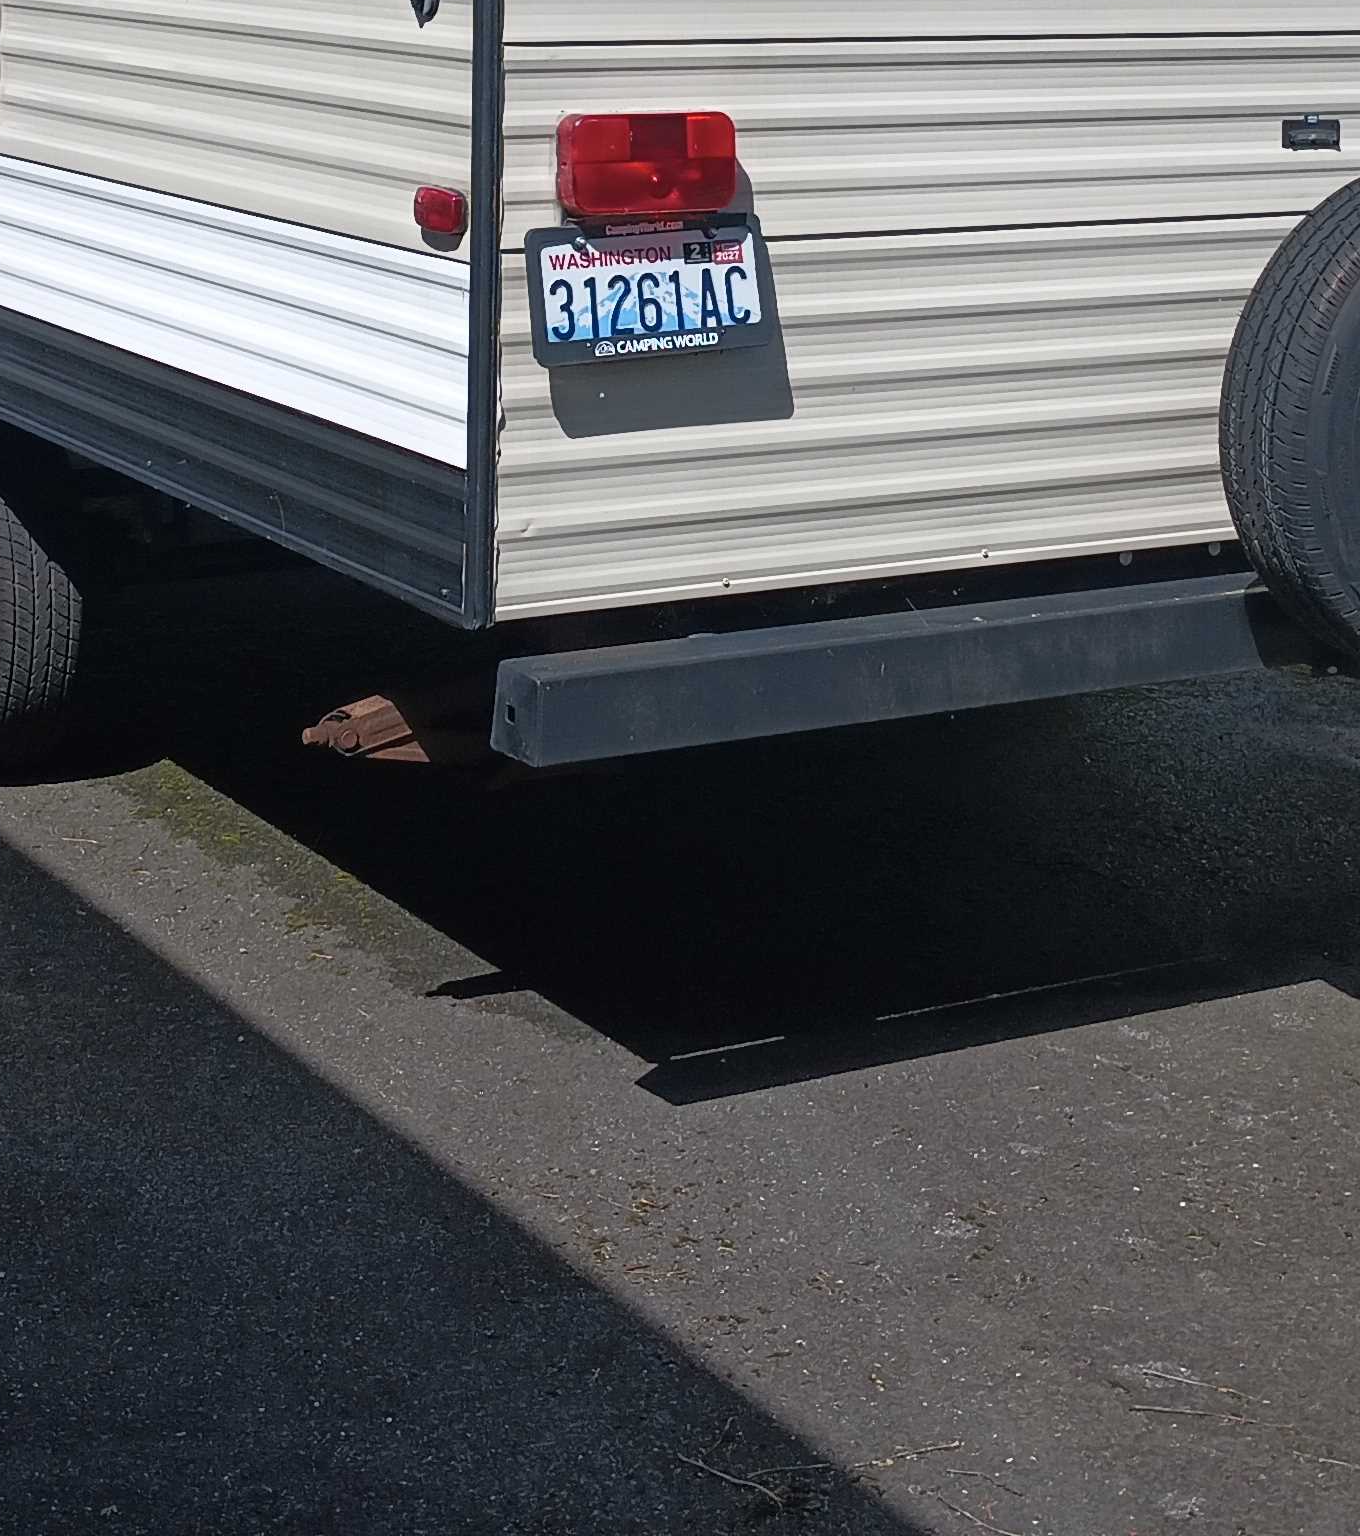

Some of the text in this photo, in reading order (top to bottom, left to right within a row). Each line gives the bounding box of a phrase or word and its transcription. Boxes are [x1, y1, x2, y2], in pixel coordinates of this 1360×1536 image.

[549, 246, 671, 270] WASHINGTON
[690, 244, 702, 259] 2
[549, 265, 751, 341] 31261AC
[617, 333, 719, 353] CAMPING WORLD
